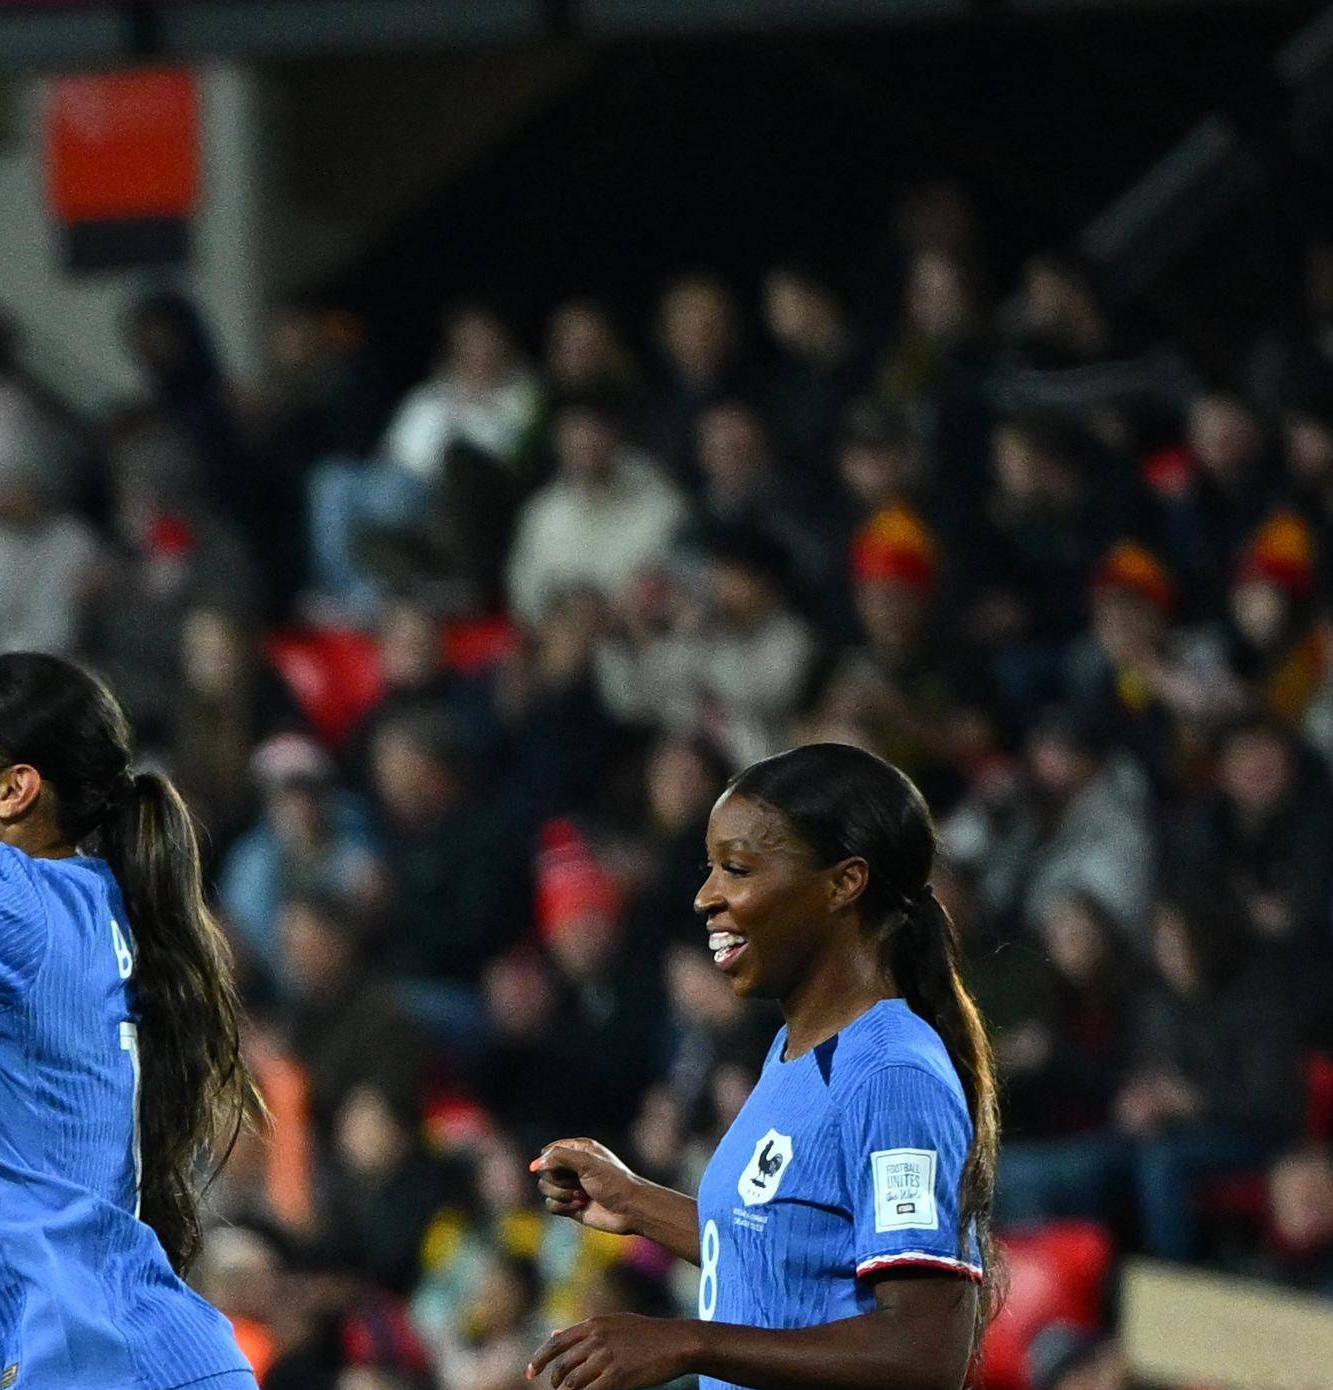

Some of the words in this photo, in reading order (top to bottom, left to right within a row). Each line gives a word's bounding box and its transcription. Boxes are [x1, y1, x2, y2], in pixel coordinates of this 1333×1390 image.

[886, 1162, 921, 1175] FOOTBALL
[887, 1174, 921, 1189] UNITES
[698, 1218, 720, 1322] 8
